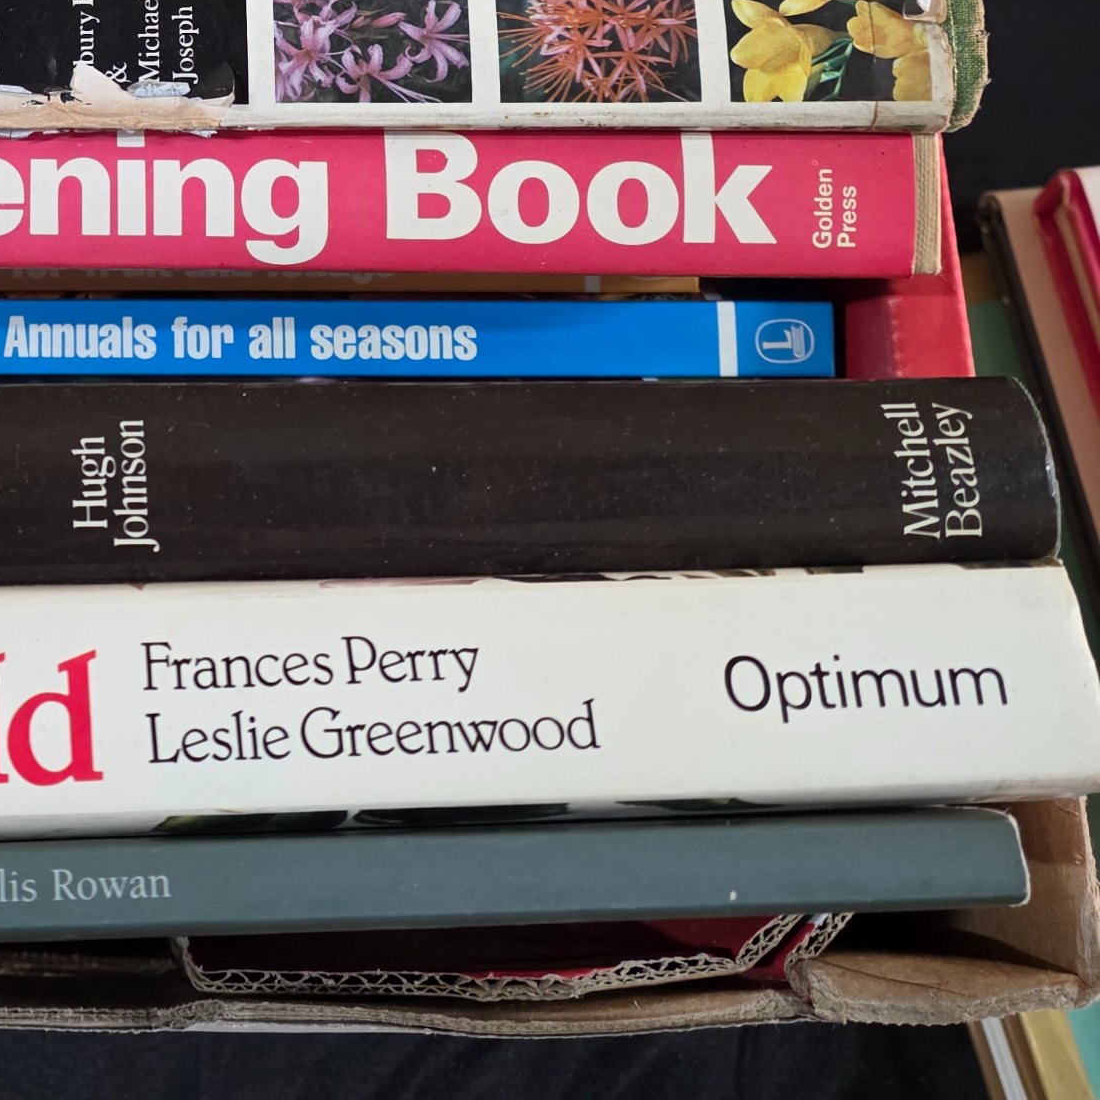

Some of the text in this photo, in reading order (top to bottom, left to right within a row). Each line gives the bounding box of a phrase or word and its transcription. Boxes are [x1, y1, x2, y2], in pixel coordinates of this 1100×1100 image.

[73, 10, 100, 66] bury
[172, 5, 200, 85] Joseph
[384, 132, 777, 245] Book
[811, 168, 833, 249] Golden
[837, 185, 857, 248] Press
[3, 313, 479, 362] Annuals for all seasons
[72, 435, 116, 530] Hugh
[114, 418, 160, 553] Johnson
[880, 402, 941, 539] Mitchell
[932, 402, 983, 537] Beazley
[141, 634, 479, 693] Frances Perry
[723, 654, 1008, 724] Optimum
[146, 698, 601, 766] Leslie Greenwood
[48, 864, 172, 904] Rowan
